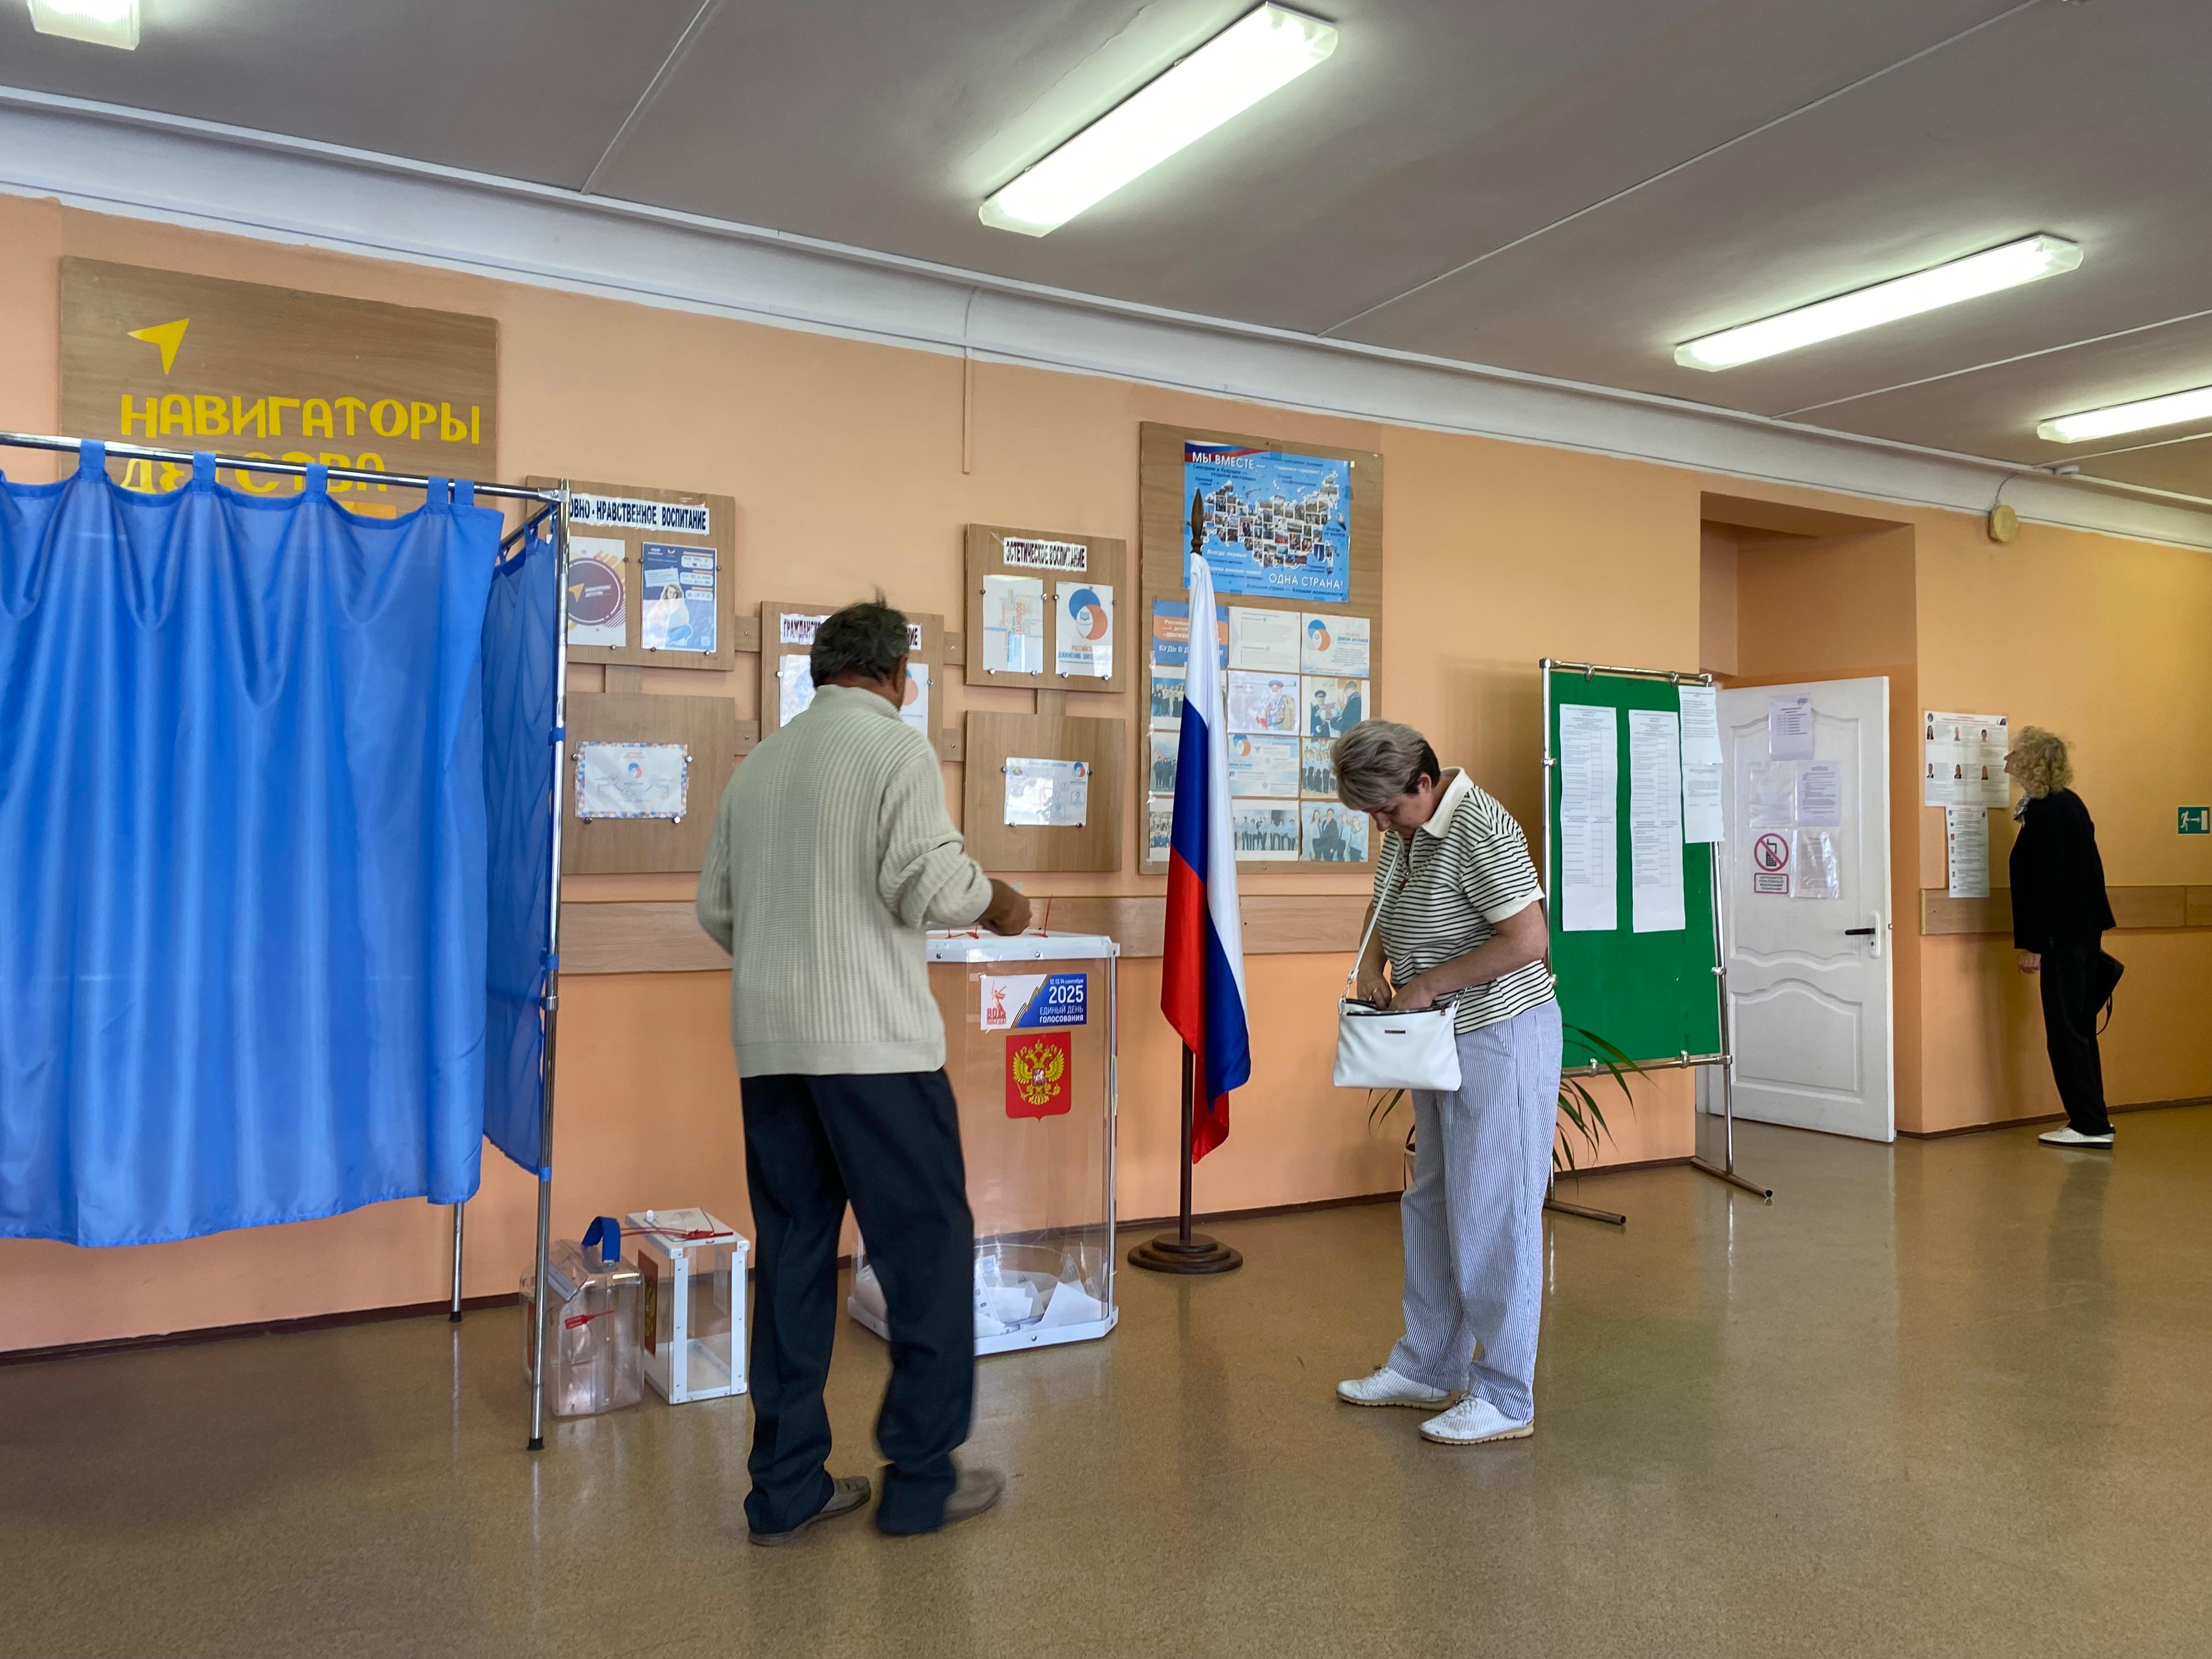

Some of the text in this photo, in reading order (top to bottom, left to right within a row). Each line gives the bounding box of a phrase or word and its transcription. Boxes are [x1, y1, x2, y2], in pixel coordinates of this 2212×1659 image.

[121, 394, 480, 444] НАВИГАТОРЫ
[1193, 452, 1211, 464] МЫ
[1215, 454, 1254, 469] ВМЕСТЕ
[120, 450, 387, 494] ДЕСТВА
[597, 501, 657, 524] НРАВСТВЕННОЕ
[662, 507, 706, 530] ВОСПИТАНИЕ
[1007, 540, 1085, 568] ЭСТЕТИЧЕСКОЕ ВОСПИТАНИЕ
[1269, 573, 1344, 590] ОДНА СТРАНА!
[1159, 645, 1177, 653] БУДЬ
[1049, 985, 1084, 1004] 2025
[1040, 1005, 1084, 1015] ЕДИНЫЙ ДЕНЬ
